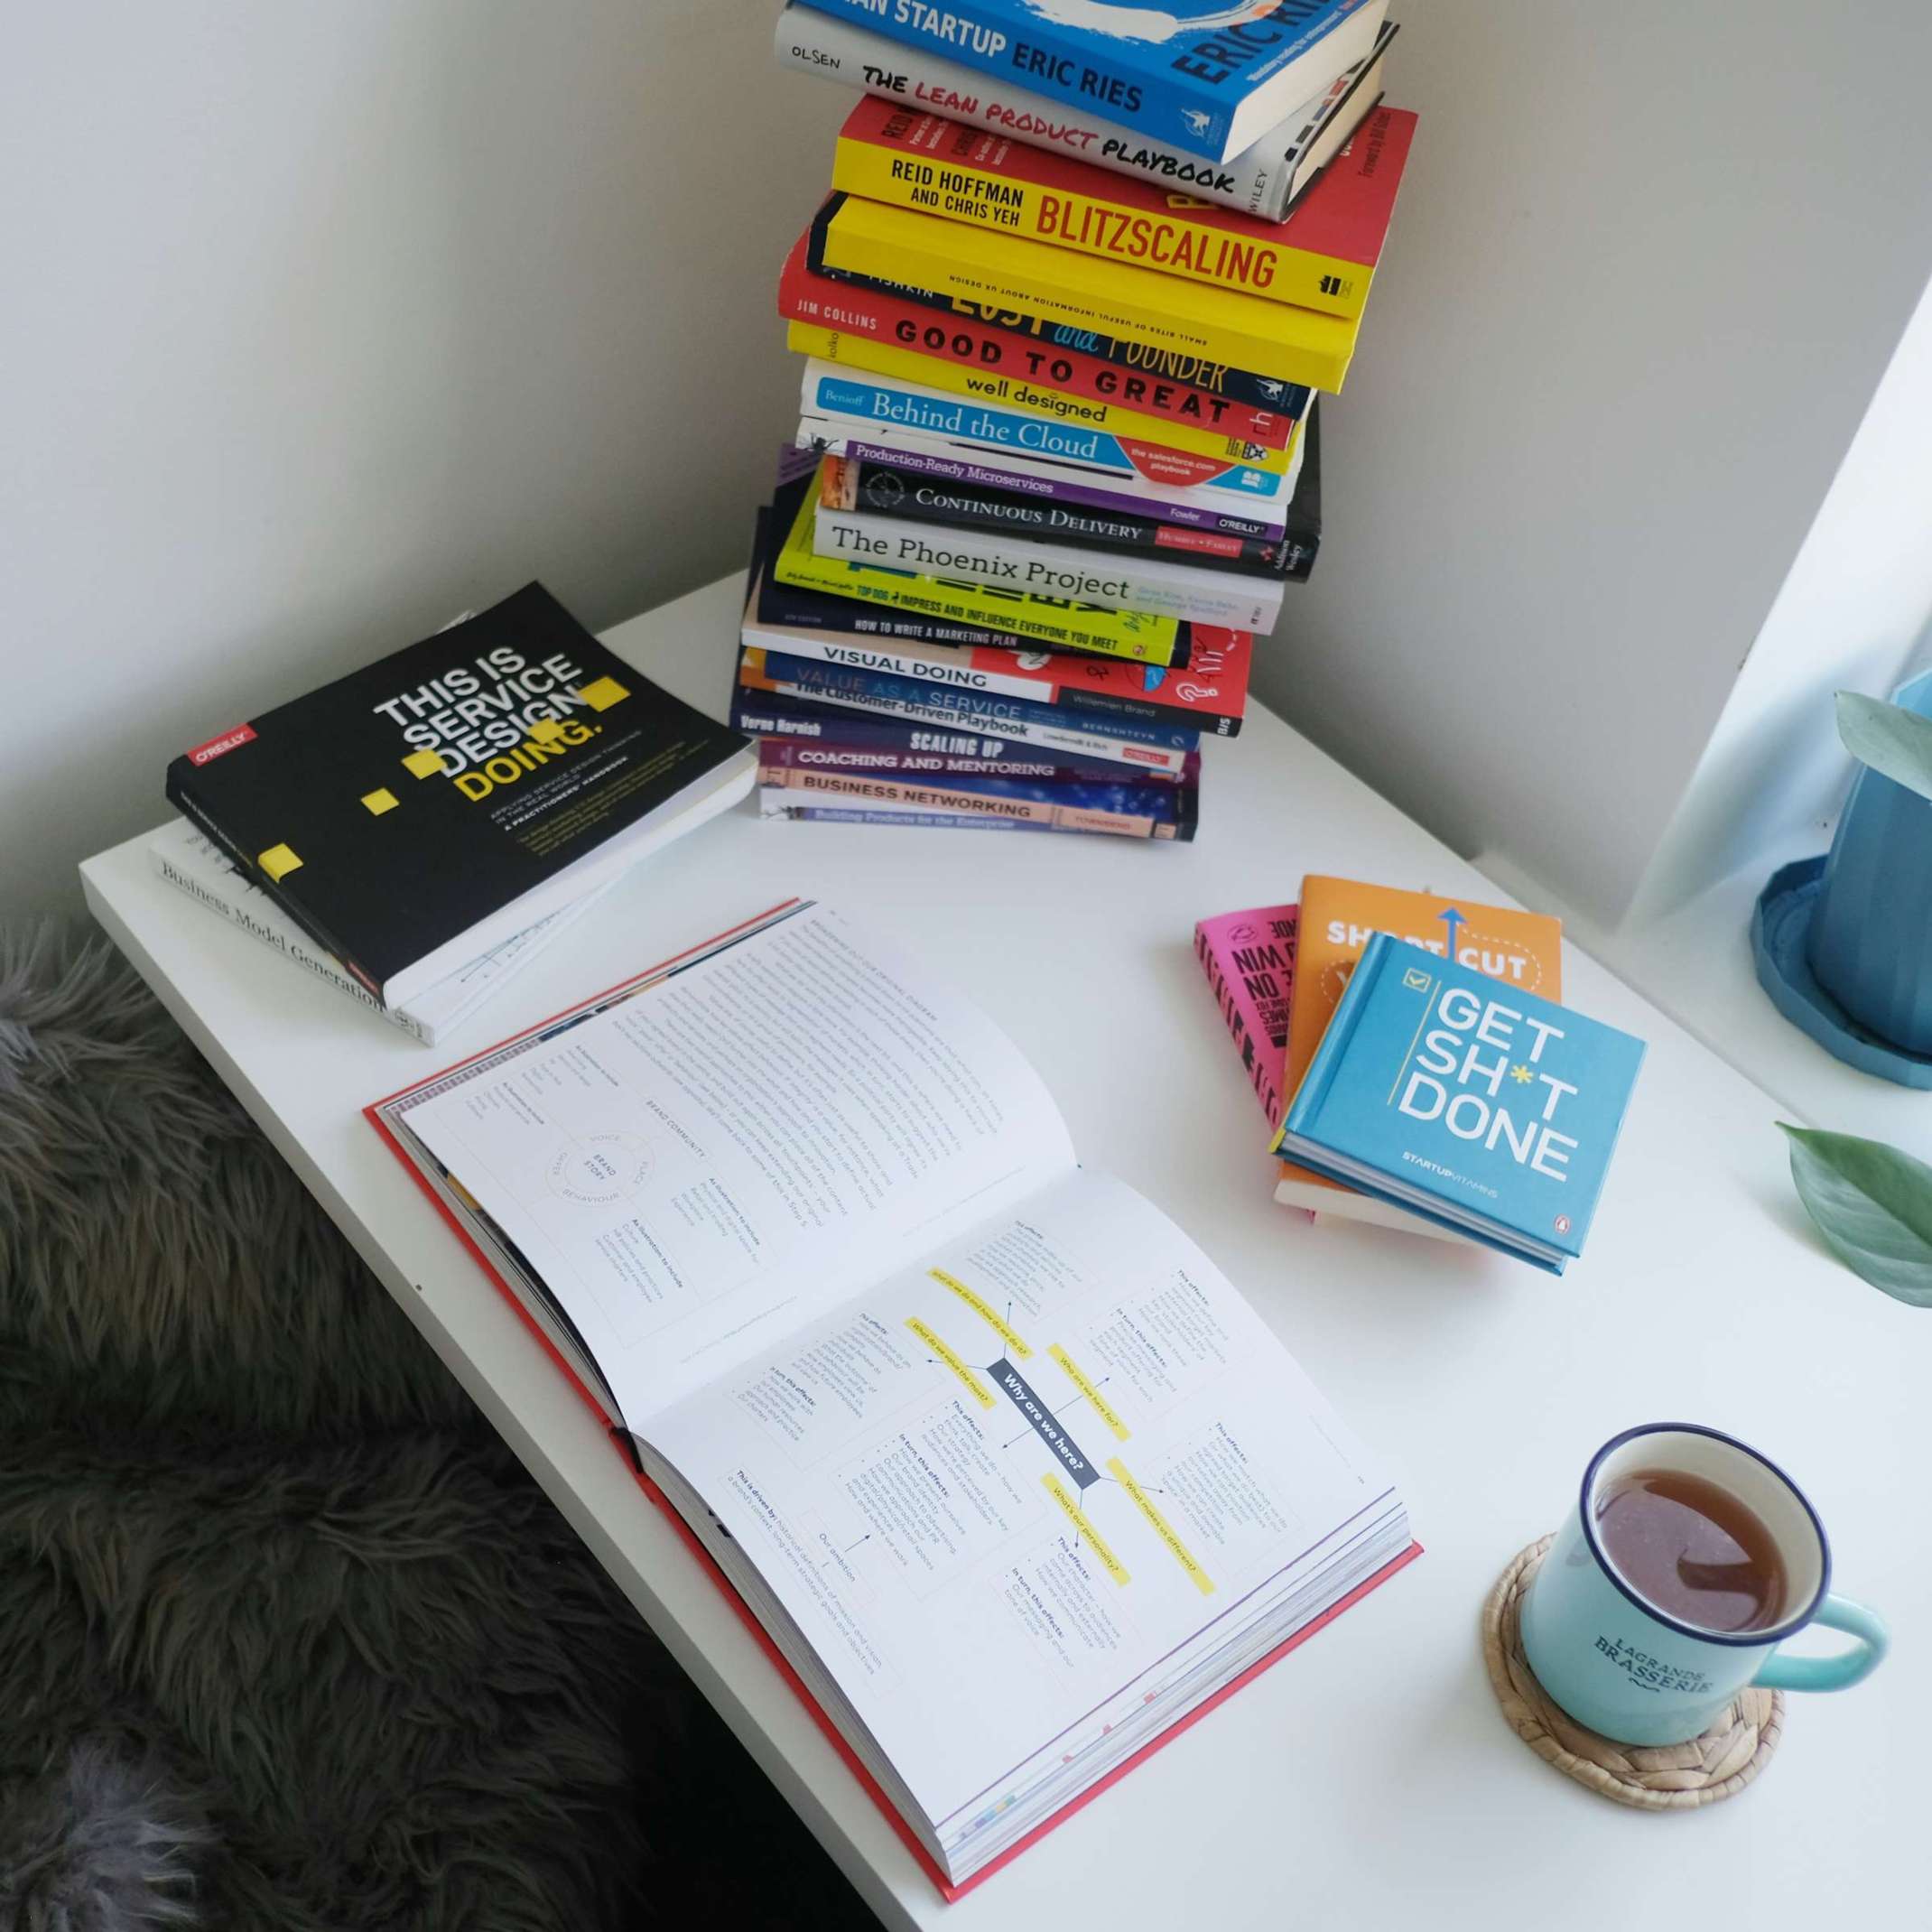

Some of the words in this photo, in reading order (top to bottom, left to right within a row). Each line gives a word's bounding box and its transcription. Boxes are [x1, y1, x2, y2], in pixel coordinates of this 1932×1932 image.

[894, 0, 1007, 58] STARTUP
[1011, 42, 1075, 87] ERIC
[1080, 68, 1143, 112] RIES
[1171, 23, 1283, 85] ERIC
[792, 46, 841, 69] OLSEN
[863, 65, 908, 94] THE
[915, 82, 978, 115] LEAN
[985, 104, 1099, 150] PRODUCT
[1101, 139, 1235, 194] PLAYBOOK
[891, 159, 933, 186] REID
[939, 171, 1024, 208] HOFFMAN
[910, 187, 939, 207] AND
[944, 196, 987, 219] CHRIS
[993, 207, 1020, 226] YEH
[1248, 169, 1268, 213] WILEY
[1036, 194, 1278, 289] BLITZSCALING
[948, 274, 982, 288] DESIGN
[985, 284, 998, 293] UX
[1001, 288, 1031, 301] ABOUT
[797, 299, 819, 315] JIM
[823, 305, 878, 330] COLLINS
[1033, 296, 1095, 318] INFORMATION
[1098, 312, 1133, 327] USEFUL
[1134, 321, 1147, 330] OF
[1149, 326, 1175, 338] BITES
[1179, 334, 1208, 347] SMALL
[896, 320, 1002, 365] GOOD
[1026, 351, 1073, 383] TO
[1095, 371, 1230, 423] GREAT
[825, 389, 865, 406] Benioff
[967, 377, 1008, 397] well
[1014, 386, 1108, 422] designed
[872, 393, 962, 432] Behind
[971, 413, 1010, 441] the
[1018, 423, 1099, 459] Cloud
[1131, 447, 1147, 459] the
[1148, 451, 1216, 471] salesforce.com
[1150, 462, 1192, 478] playbook
[856, 444, 965, 478] Production-Ready
[968, 469, 1054, 494] Microservices
[1170, 507, 1202, 522] Fowler
[1219, 519, 1261, 534] O'REILLY
[832, 525, 888, 555] The
[897, 538, 1017, 579] Phoenix
[1026, 562, 1130, 599] Project
[855, 619, 877, 631] HOW
[879, 621, 891, 633] TO
[895, 624, 924, 637] WRITE
[925, 627, 933, 637] A
[935, 627, 989, 645] MARKETING
[993, 635, 1017, 647] PLAN
[901, 594, 941, 612] IMPRESS
[945, 604, 964, 617] AND
[968, 609, 1017, 630] INFLUENCE
[1020, 620, 1069, 642] EVERYONE
[1071, 632, 1090, 645] YOU
[1091, 636, 1119, 651] MEET
[373, 669, 480, 726] THIS
[475, 647, 525, 680] IS
[824, 647, 906, 672] VISUAL
[913, 663, 987, 687] DOING
[404, 654, 583, 751] SERVICE
[796, 666, 867, 689] VALUE
[873, 683, 901, 698] AS
[929, 692, 1022, 720] SERVICE
[825, 684, 954, 722] Customer-Driven
[957, 711, 1028, 737] Playbook
[1125, 703, 1156, 717] Brand
[196, 732, 246, 762] O'REILLY
[435, 683, 587, 777] DESIGN
[740, 714, 774, 731] Verne
[777, 720, 822, 736] Harnish
[910, 732, 978, 756] SCALING
[982, 740, 1004, 758] UP
[1217, 718, 1231, 736] BIS
[453, 720, 603, 802] DOING.
[798, 751, 897, 767] COACHING
[902, 758, 943, 770] AND
[947, 759, 1054, 776] MENTORING
[803, 776, 897, 798] BUSINESS
[904, 791, 1031, 817] NETWORKING
[162, 860, 230, 915] Business
[236, 908, 285, 952] Model
[291, 944, 385, 1013] Generation
[1458, 947, 1527, 980] CUT
[1438, 988, 1565, 1063] GET
[1398, 1071, 1578, 1183] DONE
[912, 1321, 929, 1340] What
[926, 1335, 937, 1346] do
[958, 1369, 971, 1382] the
[1059, 1356, 1075, 1375] Who
[1073, 1373, 1084, 1387] are
[1082, 1386, 1092, 1398] we
[1091, 1396, 1106, 1413] here
[952, 1399, 965, 1415] This
[961, 1412, 986, 1440] affects:
[1002, 1373, 1028, 1401] Why
[1026, 1401, 1044, 1422] are
[1040, 1418, 1057, 1440] we
[1054, 1437, 1083, 1472] here?
[898, 1433, 906, 1441] In
[904, 1440, 919, 1458] turn,
[916, 1456, 930, 1471] this
[926, 1469, 951, 1498] affects:
[736, 1469, 749, 1484] This
[751, 1488, 770, 1510] driven
[1053, 1487, 1075, 1514] What's
[1072, 1514, 1084, 1528] our
[1081, 1526, 1119, 1574] personality?
[1124, 1479, 1143, 1502] What
[1140, 1501, 1161, 1527] makes
[1158, 1526, 1167, 1536] us
[1166, 1534, 1196, 1573] different?
[818, 1532, 831, 1547] Our
[829, 1547, 858, 1582] ambition
[1057, 1537, 1071, 1553] This
[1067, 1551, 1092, 1582] affects:
[1011, 1567, 1020, 1576] In
[1017, 1575, 1033, 1594] turn,
[1030, 1593, 1044, 1609] this
[1041, 1608, 1065, 1639] affects:
[1594, 1635, 1714, 1693] BRASSERIE
